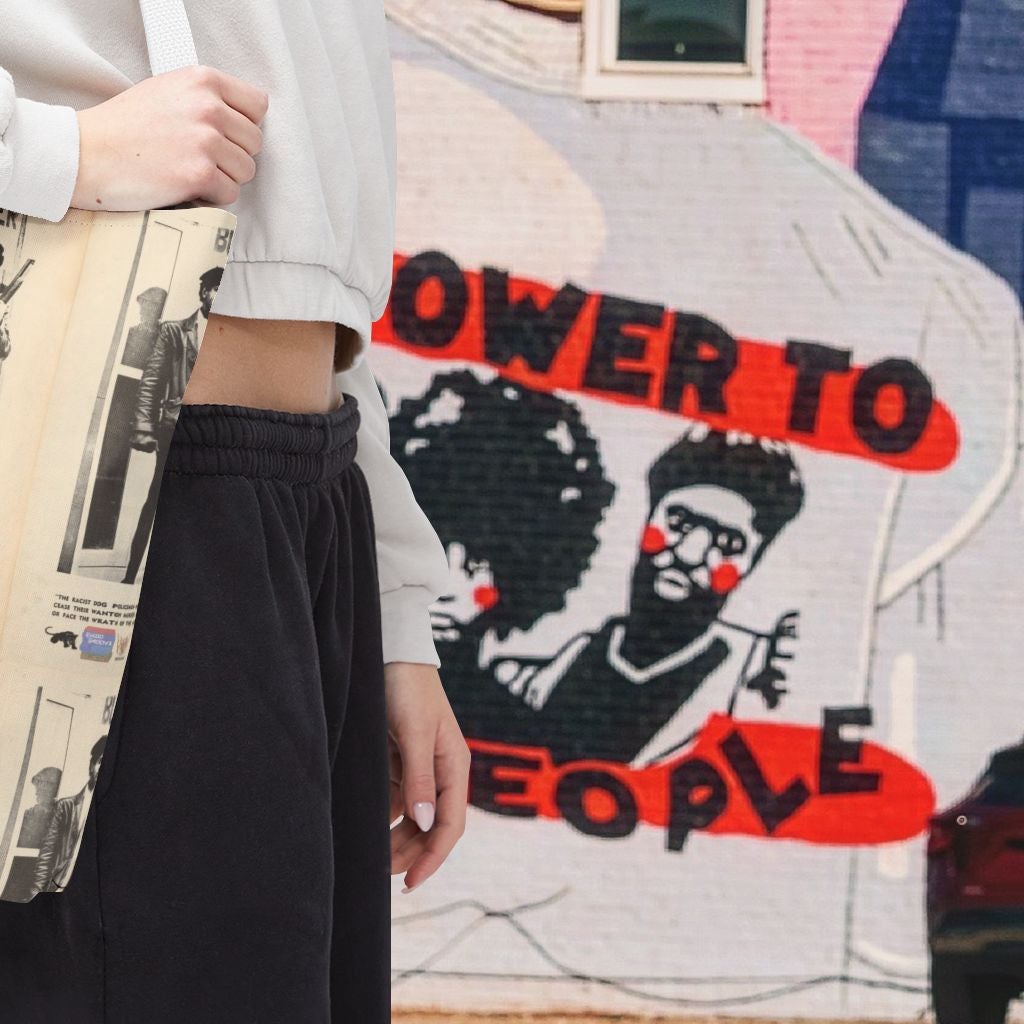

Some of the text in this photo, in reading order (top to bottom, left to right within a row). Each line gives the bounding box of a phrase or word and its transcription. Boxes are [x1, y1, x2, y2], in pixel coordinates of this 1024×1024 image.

[388, 251, 935, 455] OWER TO
[53, 602, 70, 611] CEASE
[73, 605, 89, 614] THEIR
[72, 596, 91, 605] RACIST
[93, 600, 108, 608] DOG
[62, 612, 77, 620] FACE
[470, 708, 882, 854] EOPLE
